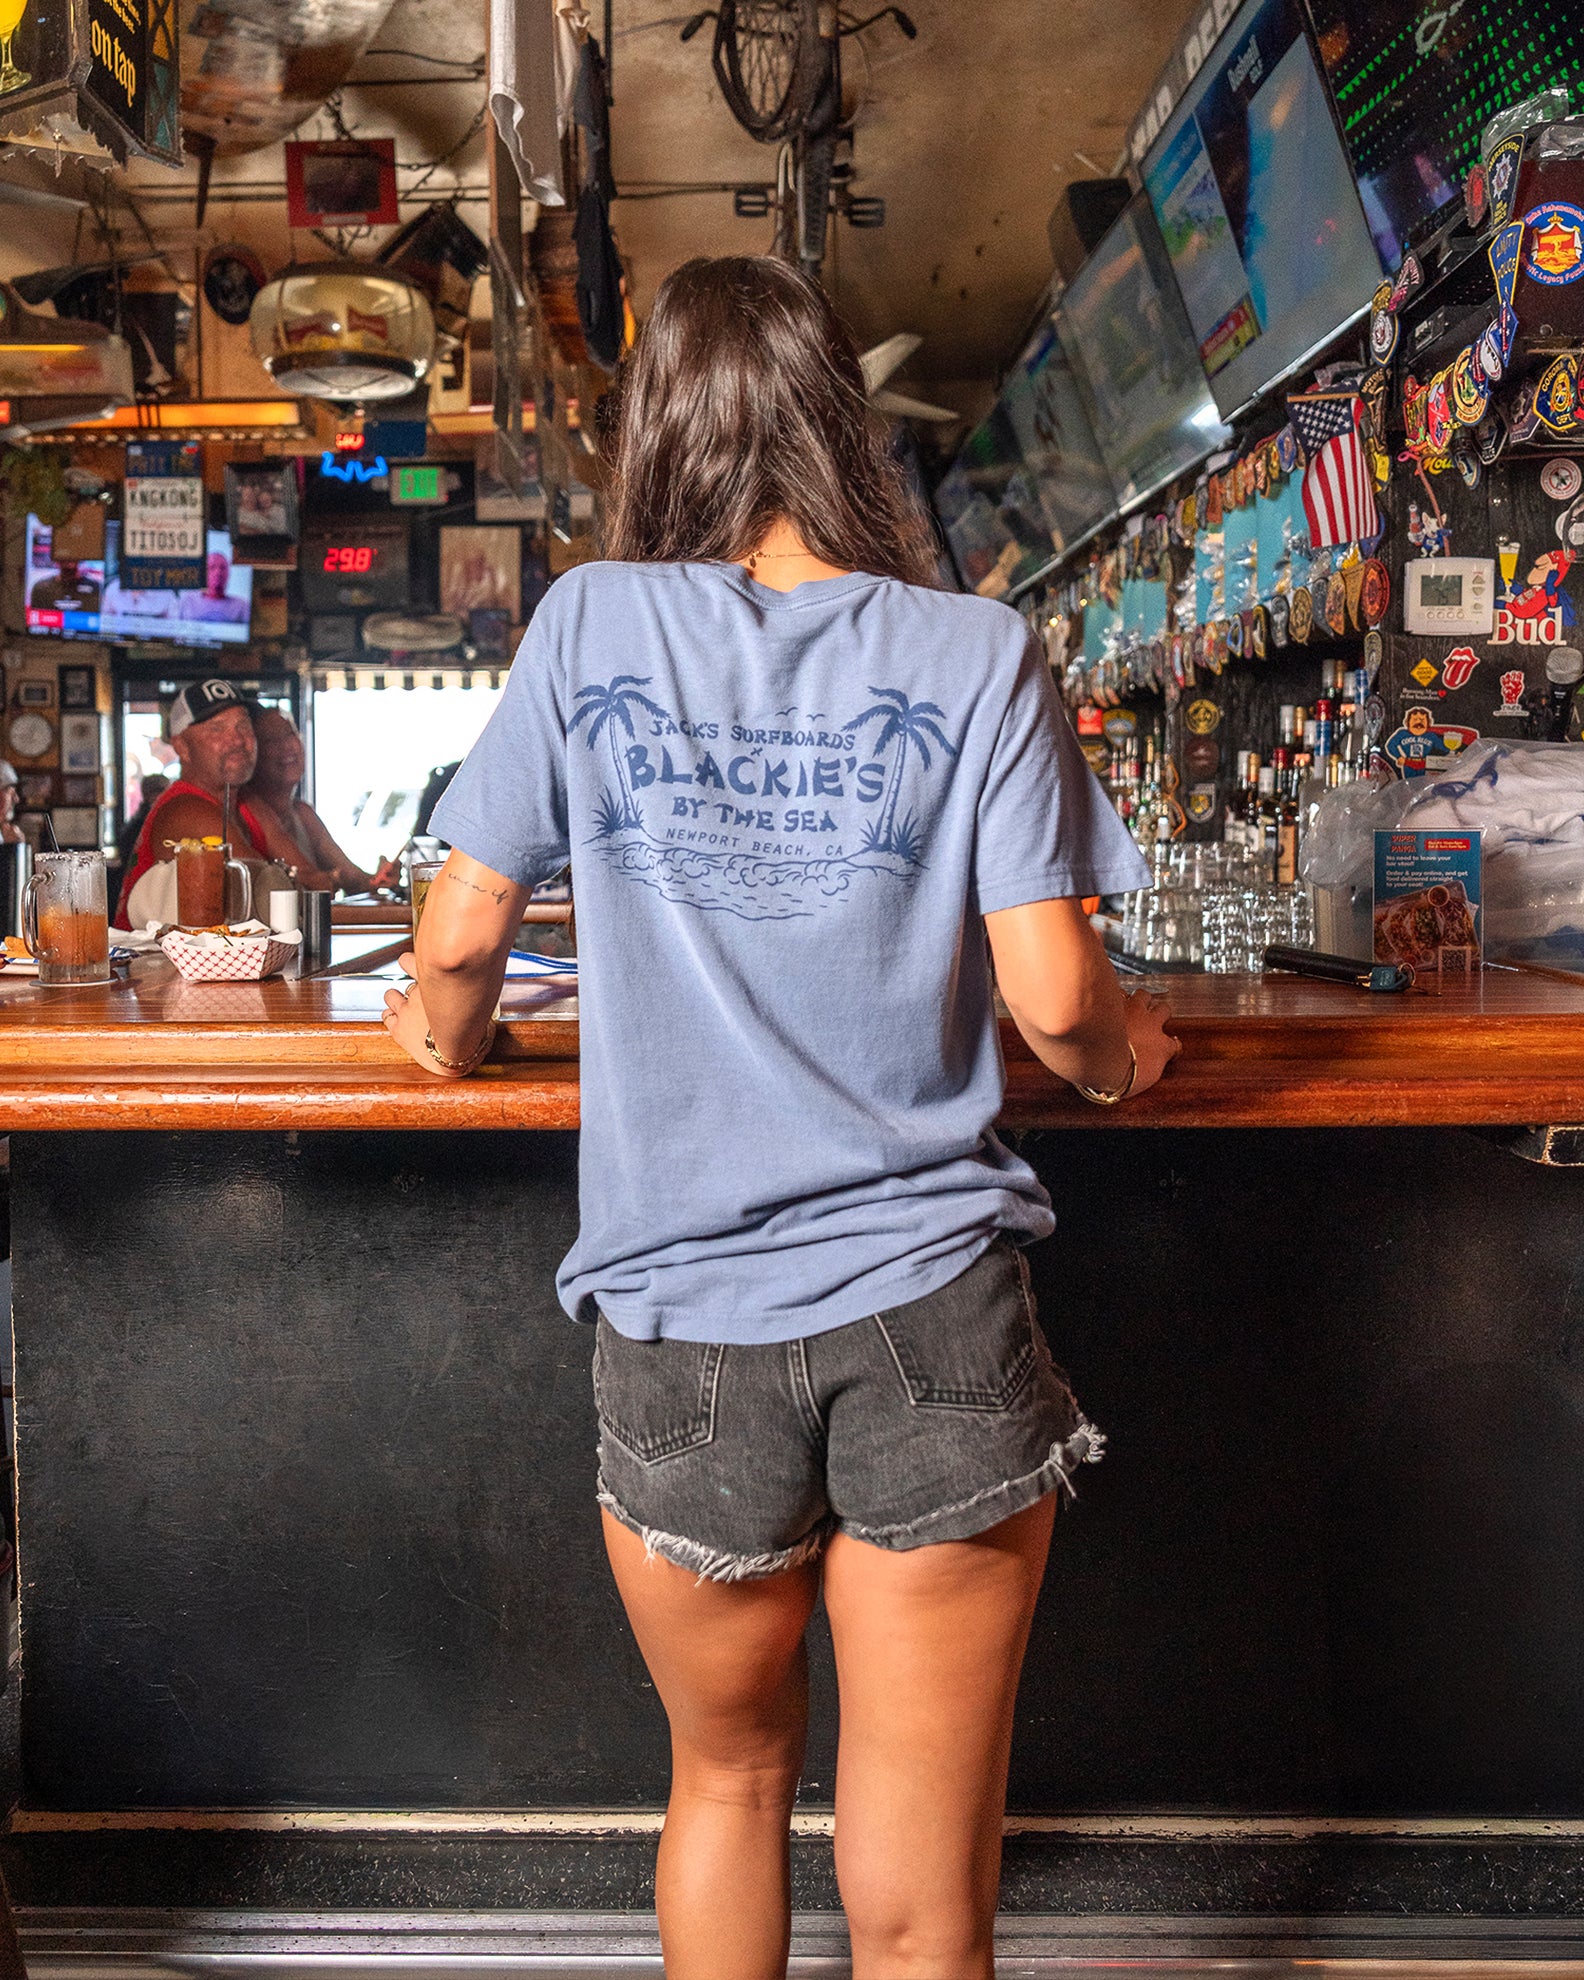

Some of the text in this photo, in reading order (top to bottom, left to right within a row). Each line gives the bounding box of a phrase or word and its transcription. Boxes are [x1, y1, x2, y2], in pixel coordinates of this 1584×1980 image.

[92, 19, 113, 72] on
[113, 36, 136, 108] tap
[1487, 606, 1567, 646] Bud
[648, 718, 856, 751] JACK'S SURFBOARDS
[1401, 737, 1416, 746] COOL
[624, 744, 888, 803] BLACKIE'S
[672, 796, 838, 833] BY THE SEA
[666, 828, 844, 857] NEWPORT BEACH, CA
[1391, 835, 1416, 843] SUPER
